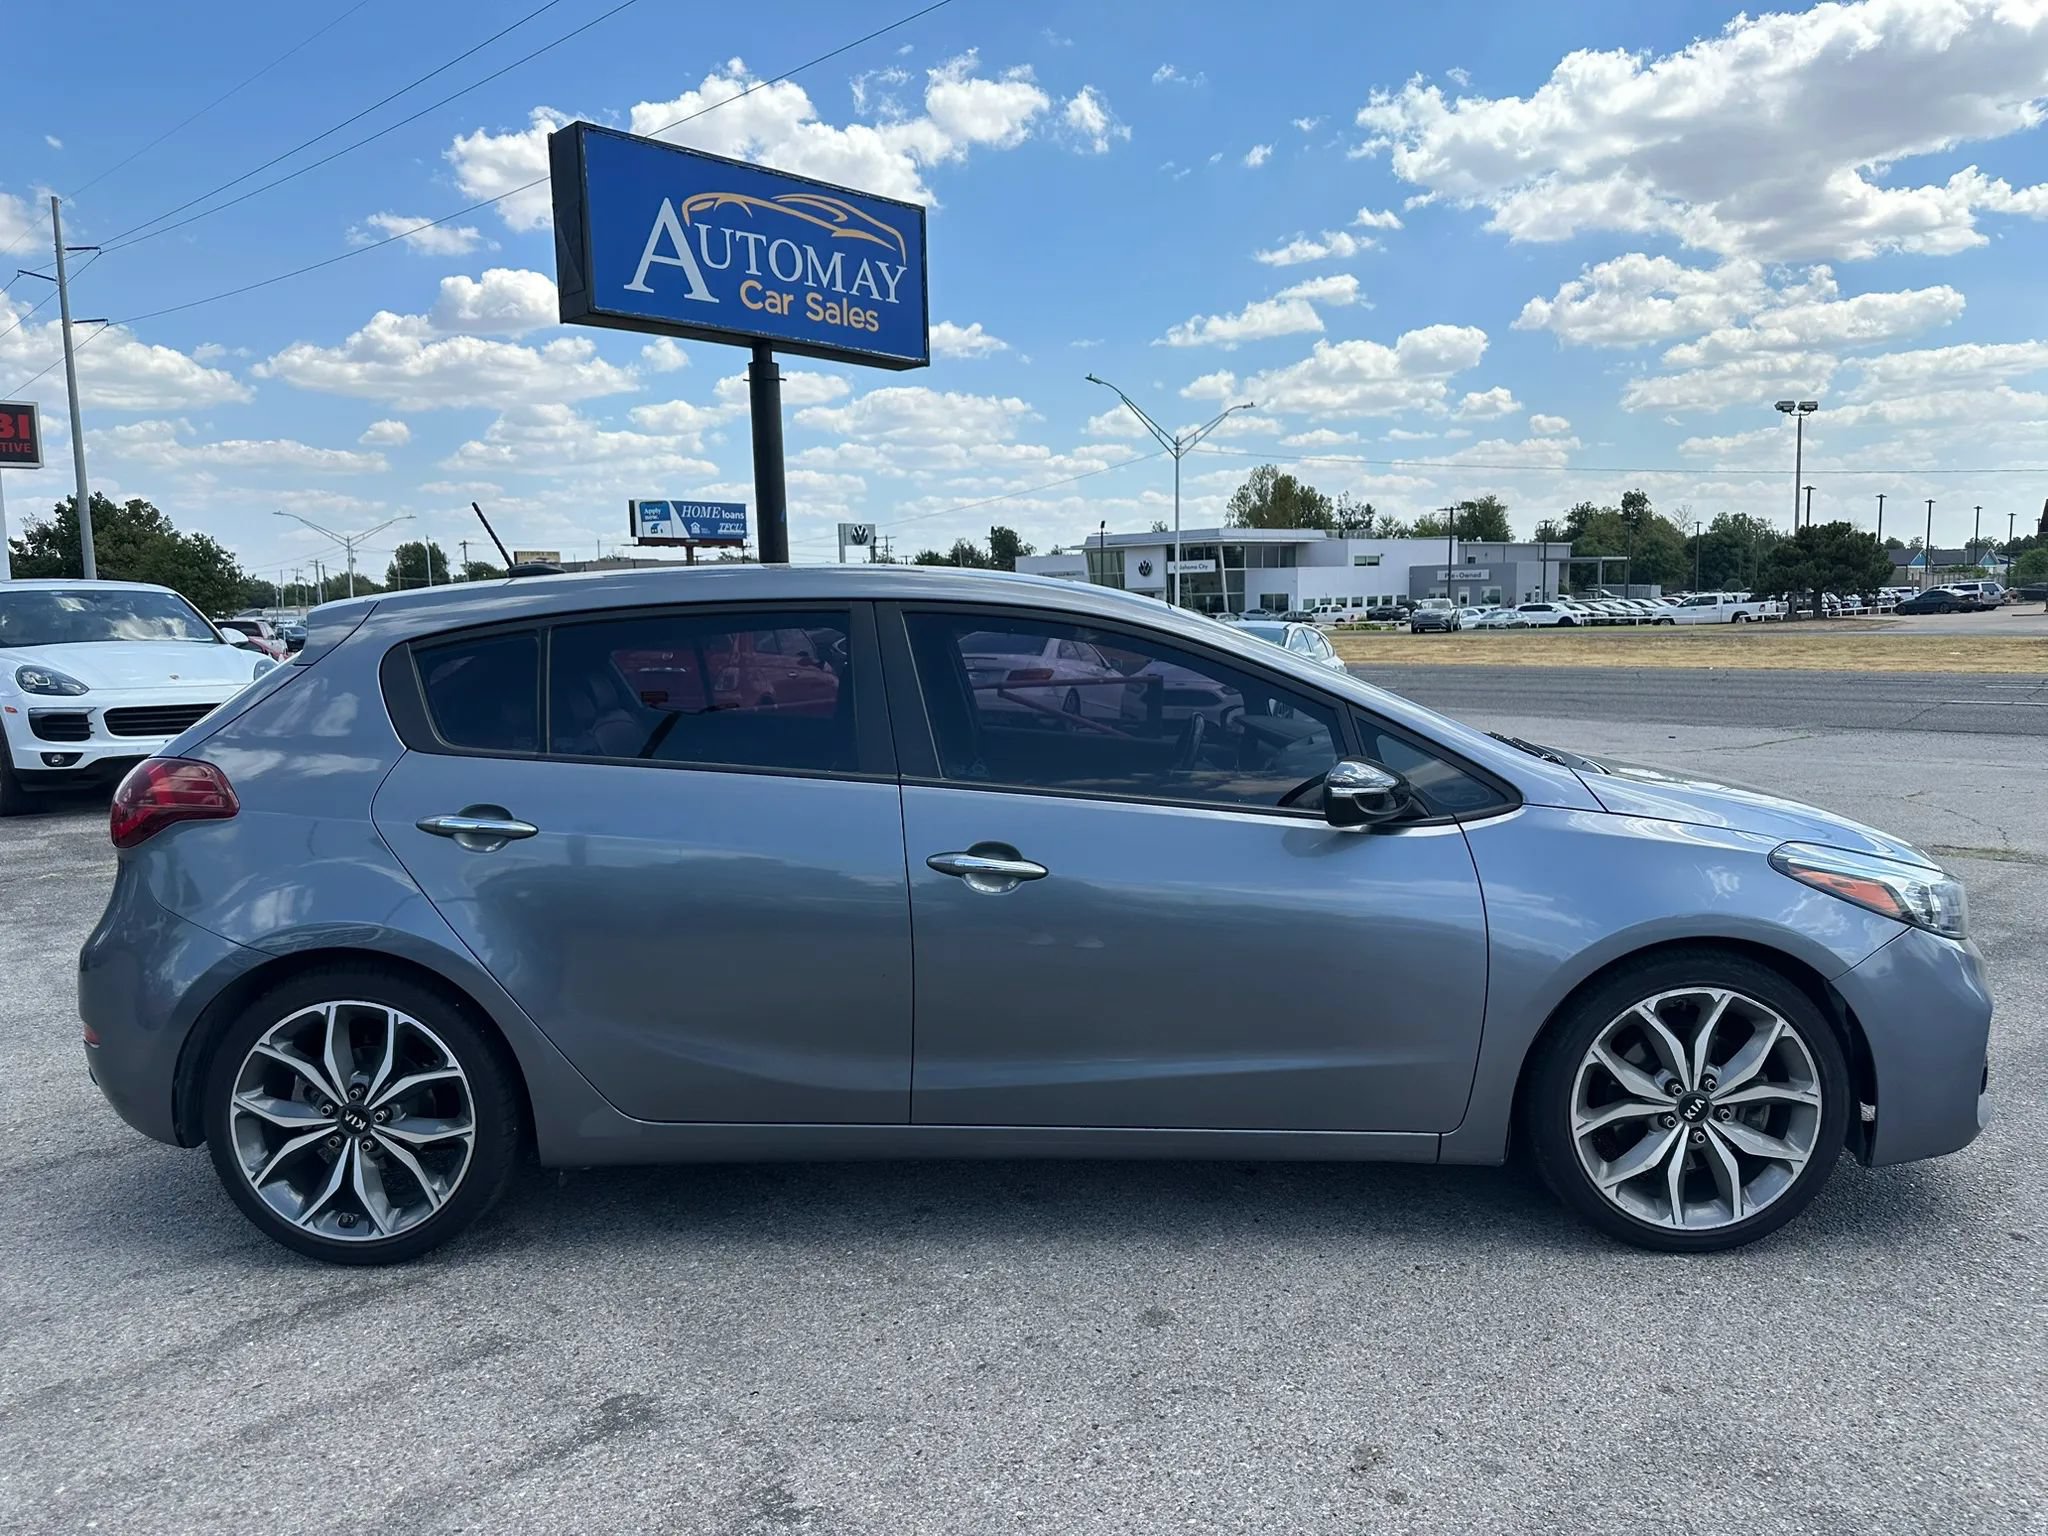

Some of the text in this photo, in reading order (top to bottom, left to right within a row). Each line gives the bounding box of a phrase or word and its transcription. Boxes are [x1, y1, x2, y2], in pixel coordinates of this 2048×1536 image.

[739, 280, 880, 333] Car Sales
[643, 507, 661, 516] Apply
[681, 505, 745, 519] HOME loans
